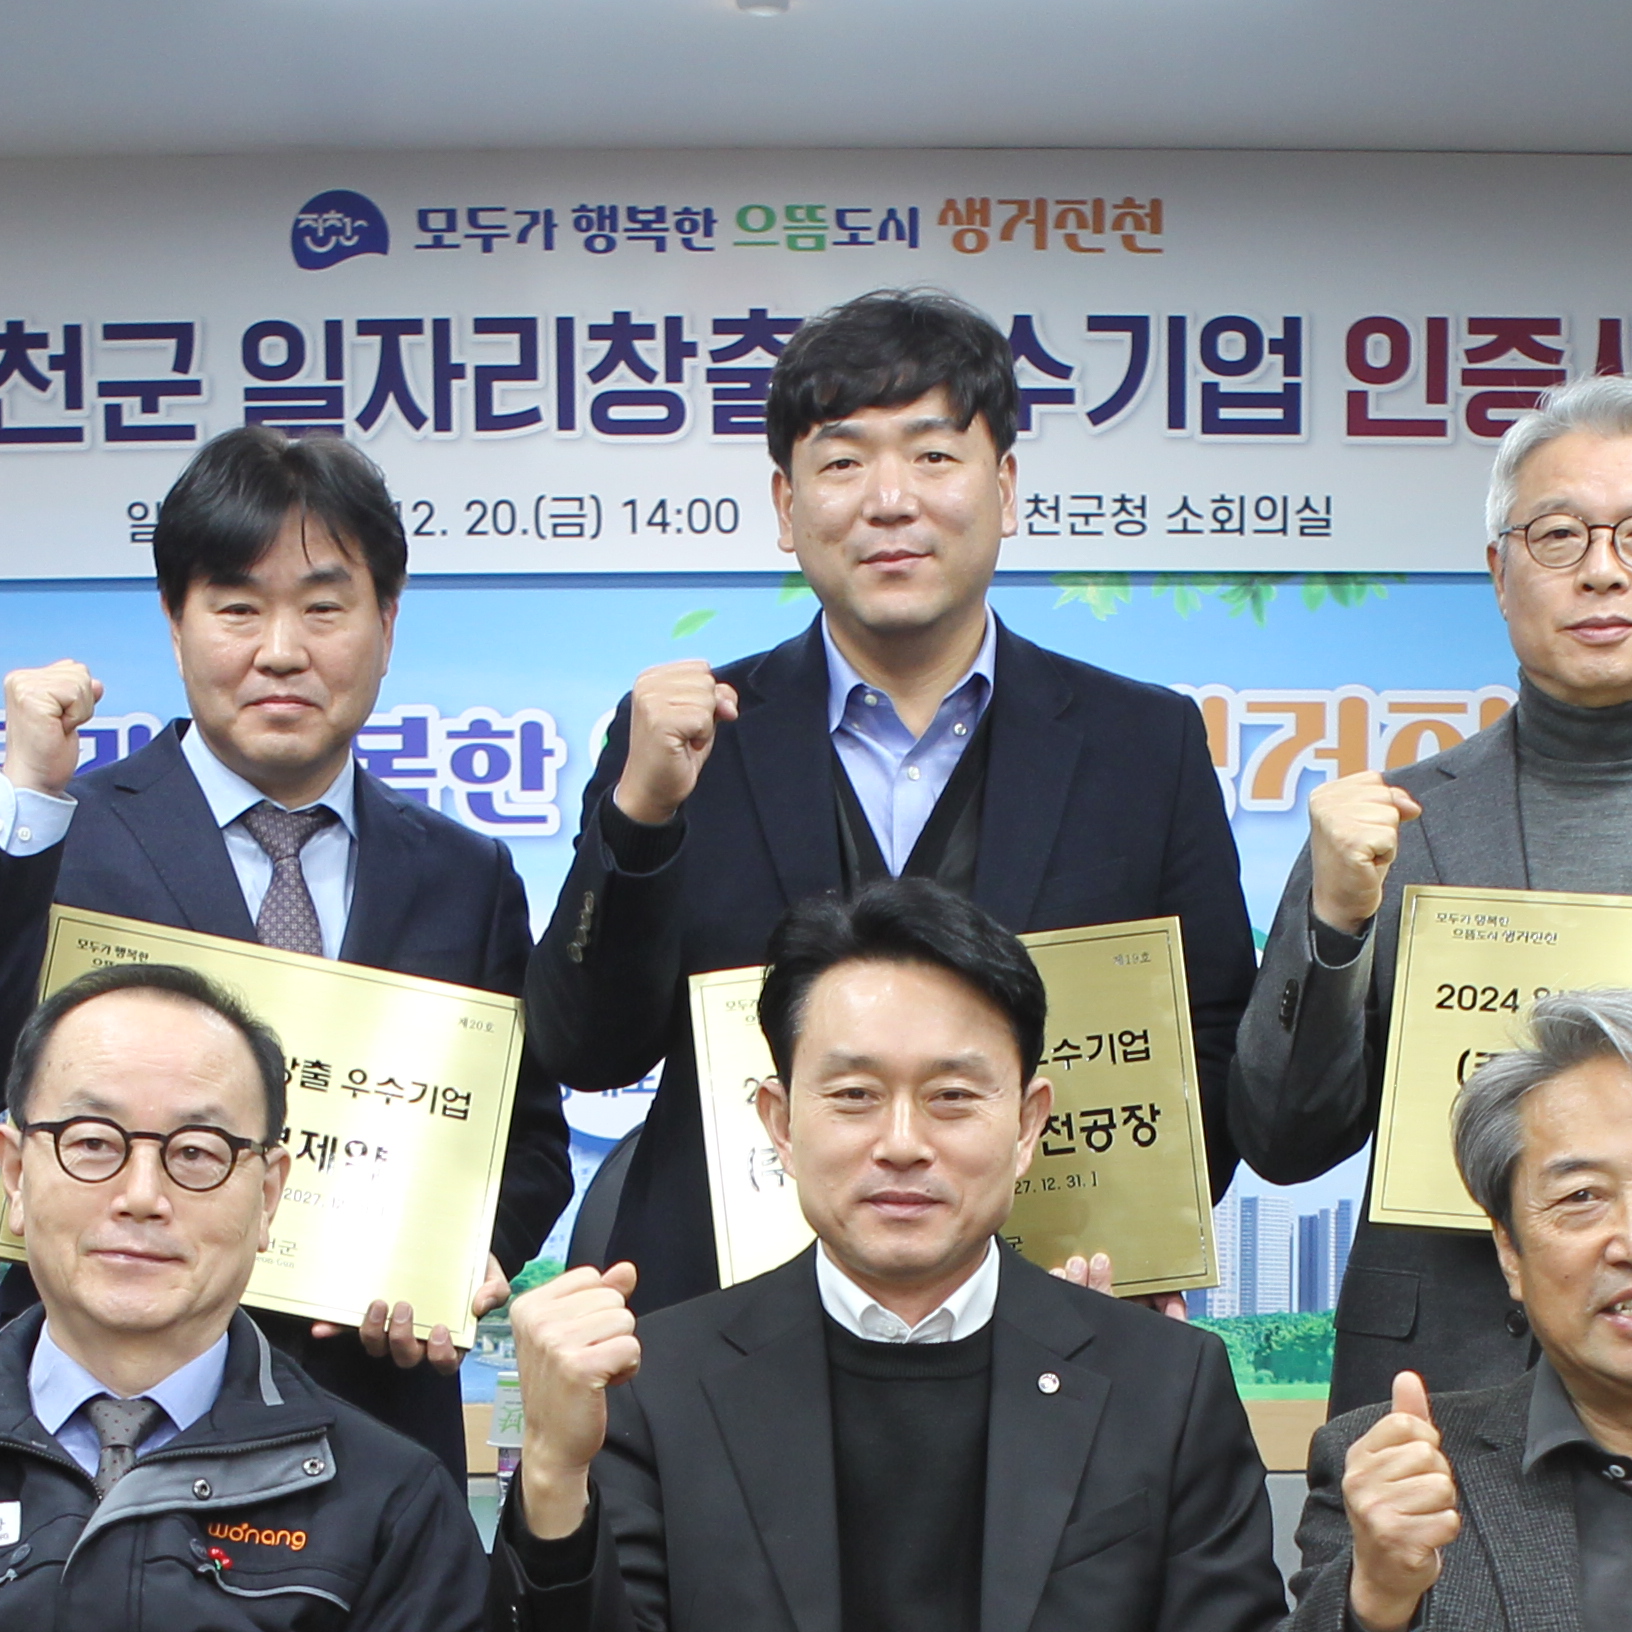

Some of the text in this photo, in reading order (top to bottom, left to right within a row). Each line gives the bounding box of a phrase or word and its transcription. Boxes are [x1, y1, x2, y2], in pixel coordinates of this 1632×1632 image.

[414, 197, 1164, 254] 모두가 행복한 으뜸도시 생거진천
[621, 498, 740, 535] 14:00
[1165, 494, 1333, 538] 소회의실
[1436, 984, 1520, 1013] 2024
[341, 1068, 472, 1121] 우수기업
[1042, 1176, 1062, 1192] 12.
[1066, 1174, 1087, 1189] 31.
[208, 1521, 307, 1551] wonang
